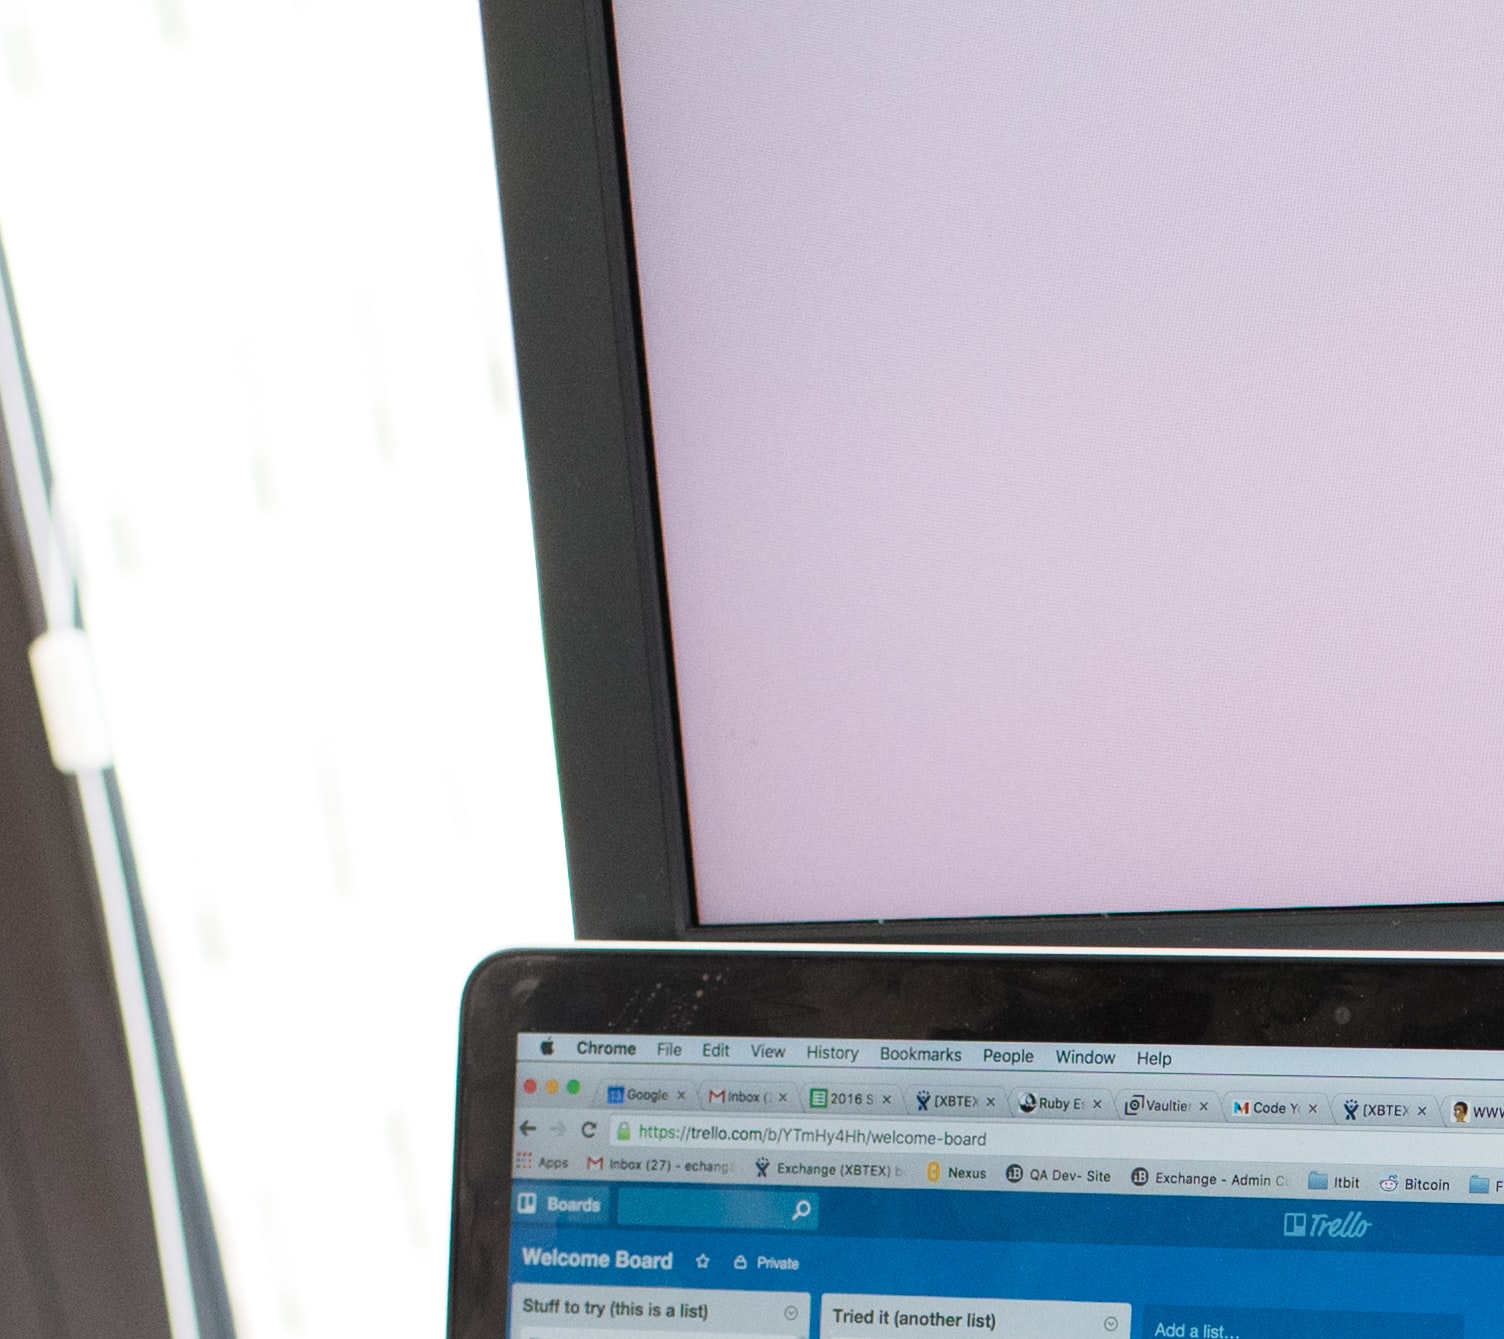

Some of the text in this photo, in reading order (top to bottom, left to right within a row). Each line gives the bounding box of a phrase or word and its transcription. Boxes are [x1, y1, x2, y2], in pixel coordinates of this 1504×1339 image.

[576, 1040, 1172, 1068] Chrome File Edit View History Bookmarks People Window Help
[639, 1124, 987, 1146] https://trello.com/b/YTmHy4Hh/welcome-board
[538, 1156, 569, 1169] Apps
[948, 1167, 986, 1179] Nexus
[1029, 1168, 1048, 1181] QA
[1086, 1169, 1111, 1182] Site
[1334, 1176, 1359, 1189] Itbit
[1405, 1177, 1449, 1190] Bitcoin
[547, 1197, 601, 1213] Boards
[1309, 1210, 1373, 1238] Trello
[522, 1247, 673, 1270] Welcome Board
[757, 1255, 799, 1270] Private
[522, 1297, 708, 1321] Stuff to try (this is a list)
[832, 1308, 996, 1331] Tried it (another list)
[1154, 1322, 1185, 1337] Add
[1189, 1326, 1199, 1338] a
